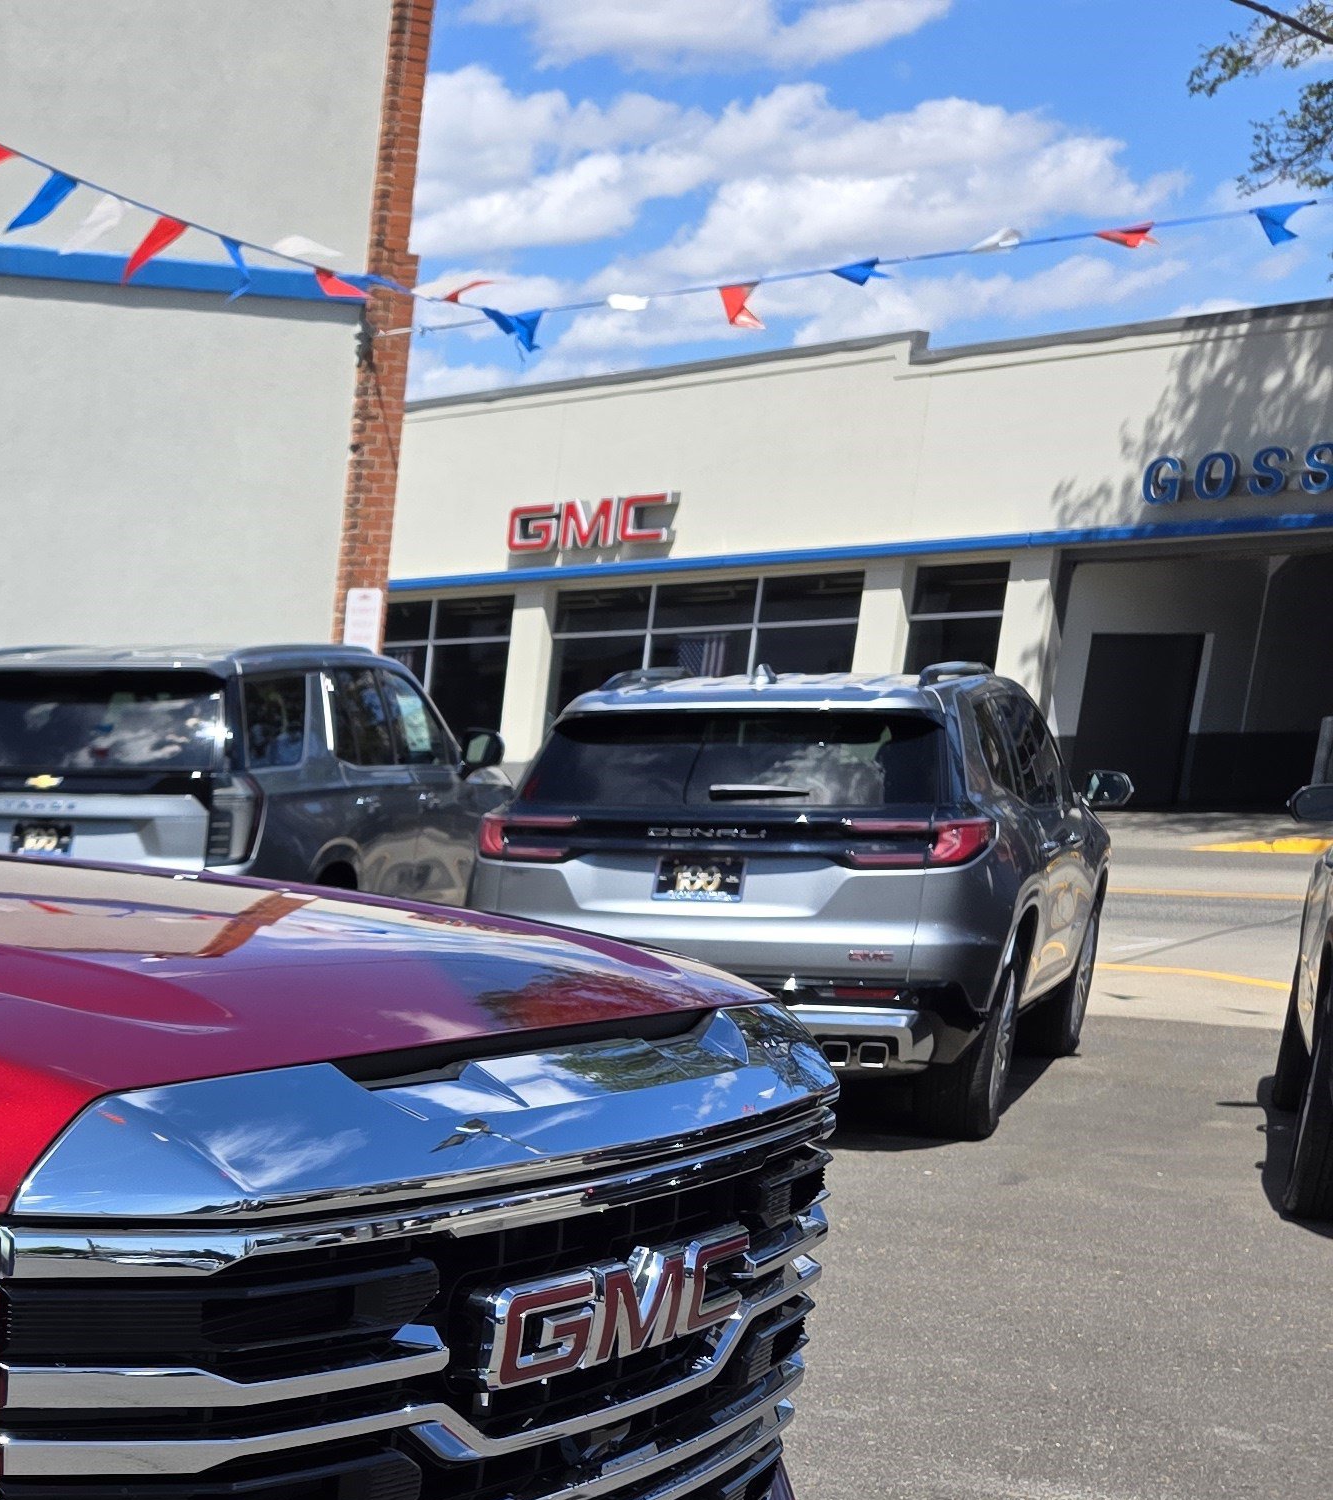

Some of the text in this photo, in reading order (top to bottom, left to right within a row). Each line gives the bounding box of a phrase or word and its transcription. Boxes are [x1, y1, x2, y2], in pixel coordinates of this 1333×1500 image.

[1141, 441, 1333, 506] GOSS
[506, 490, 673, 555] GMC
[647, 827, 768, 839] DENALI
[848, 949, 895, 961] GMC
[486, 1223, 750, 1391] GMC
